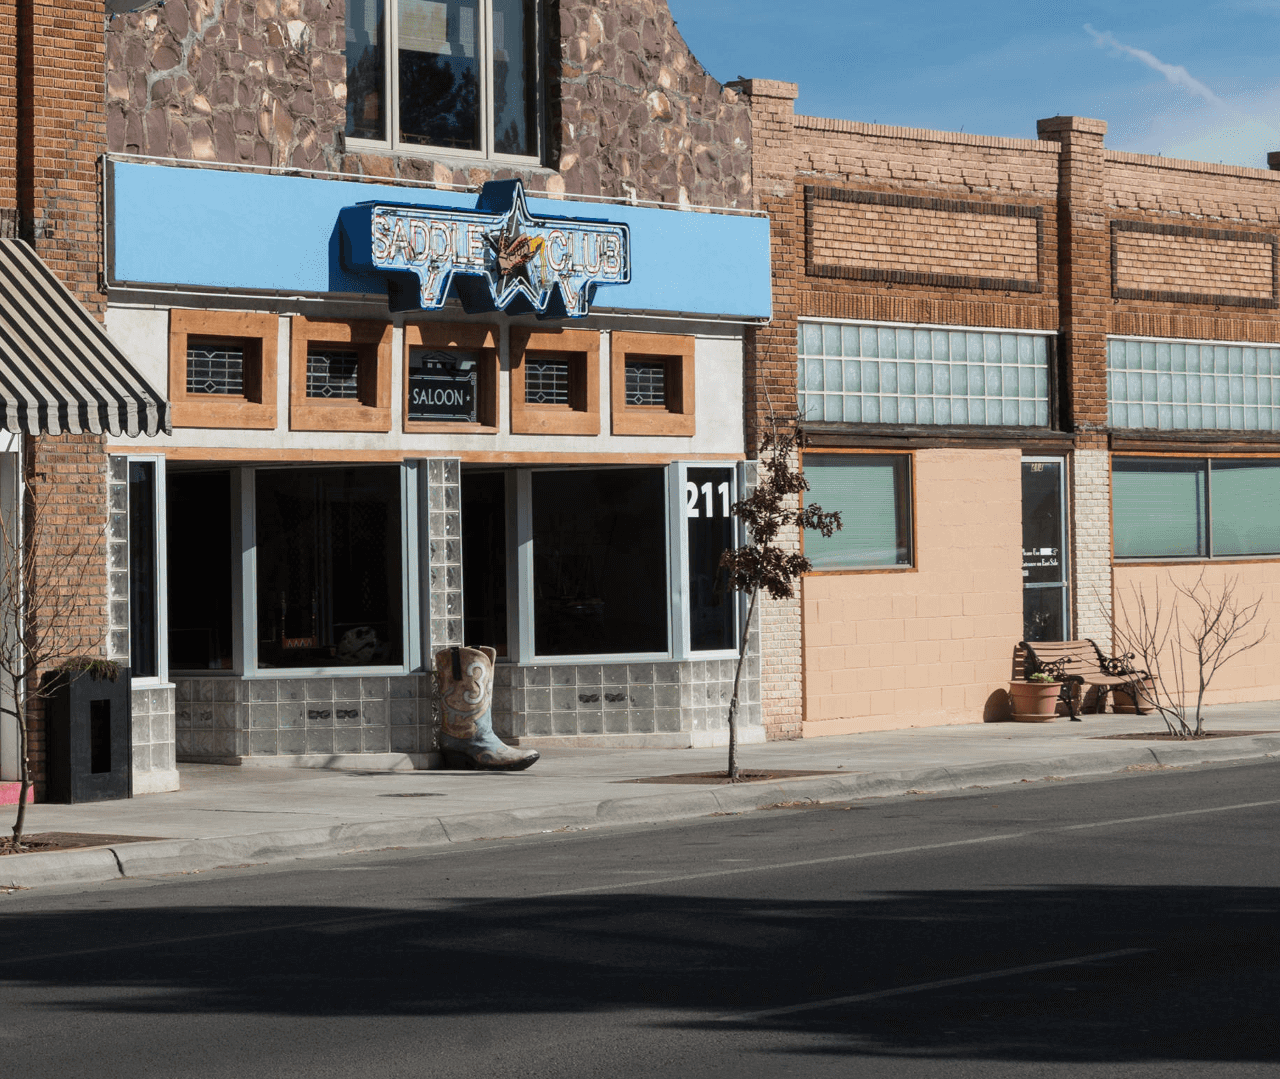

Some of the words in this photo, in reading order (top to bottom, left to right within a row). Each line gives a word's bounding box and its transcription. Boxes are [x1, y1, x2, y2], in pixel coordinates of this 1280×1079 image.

[372, 216, 485, 266] SADDLE
[546, 230, 621, 279] CLUB
[413, 388, 463, 406] SALOON
[686, 481, 730, 518] 211
